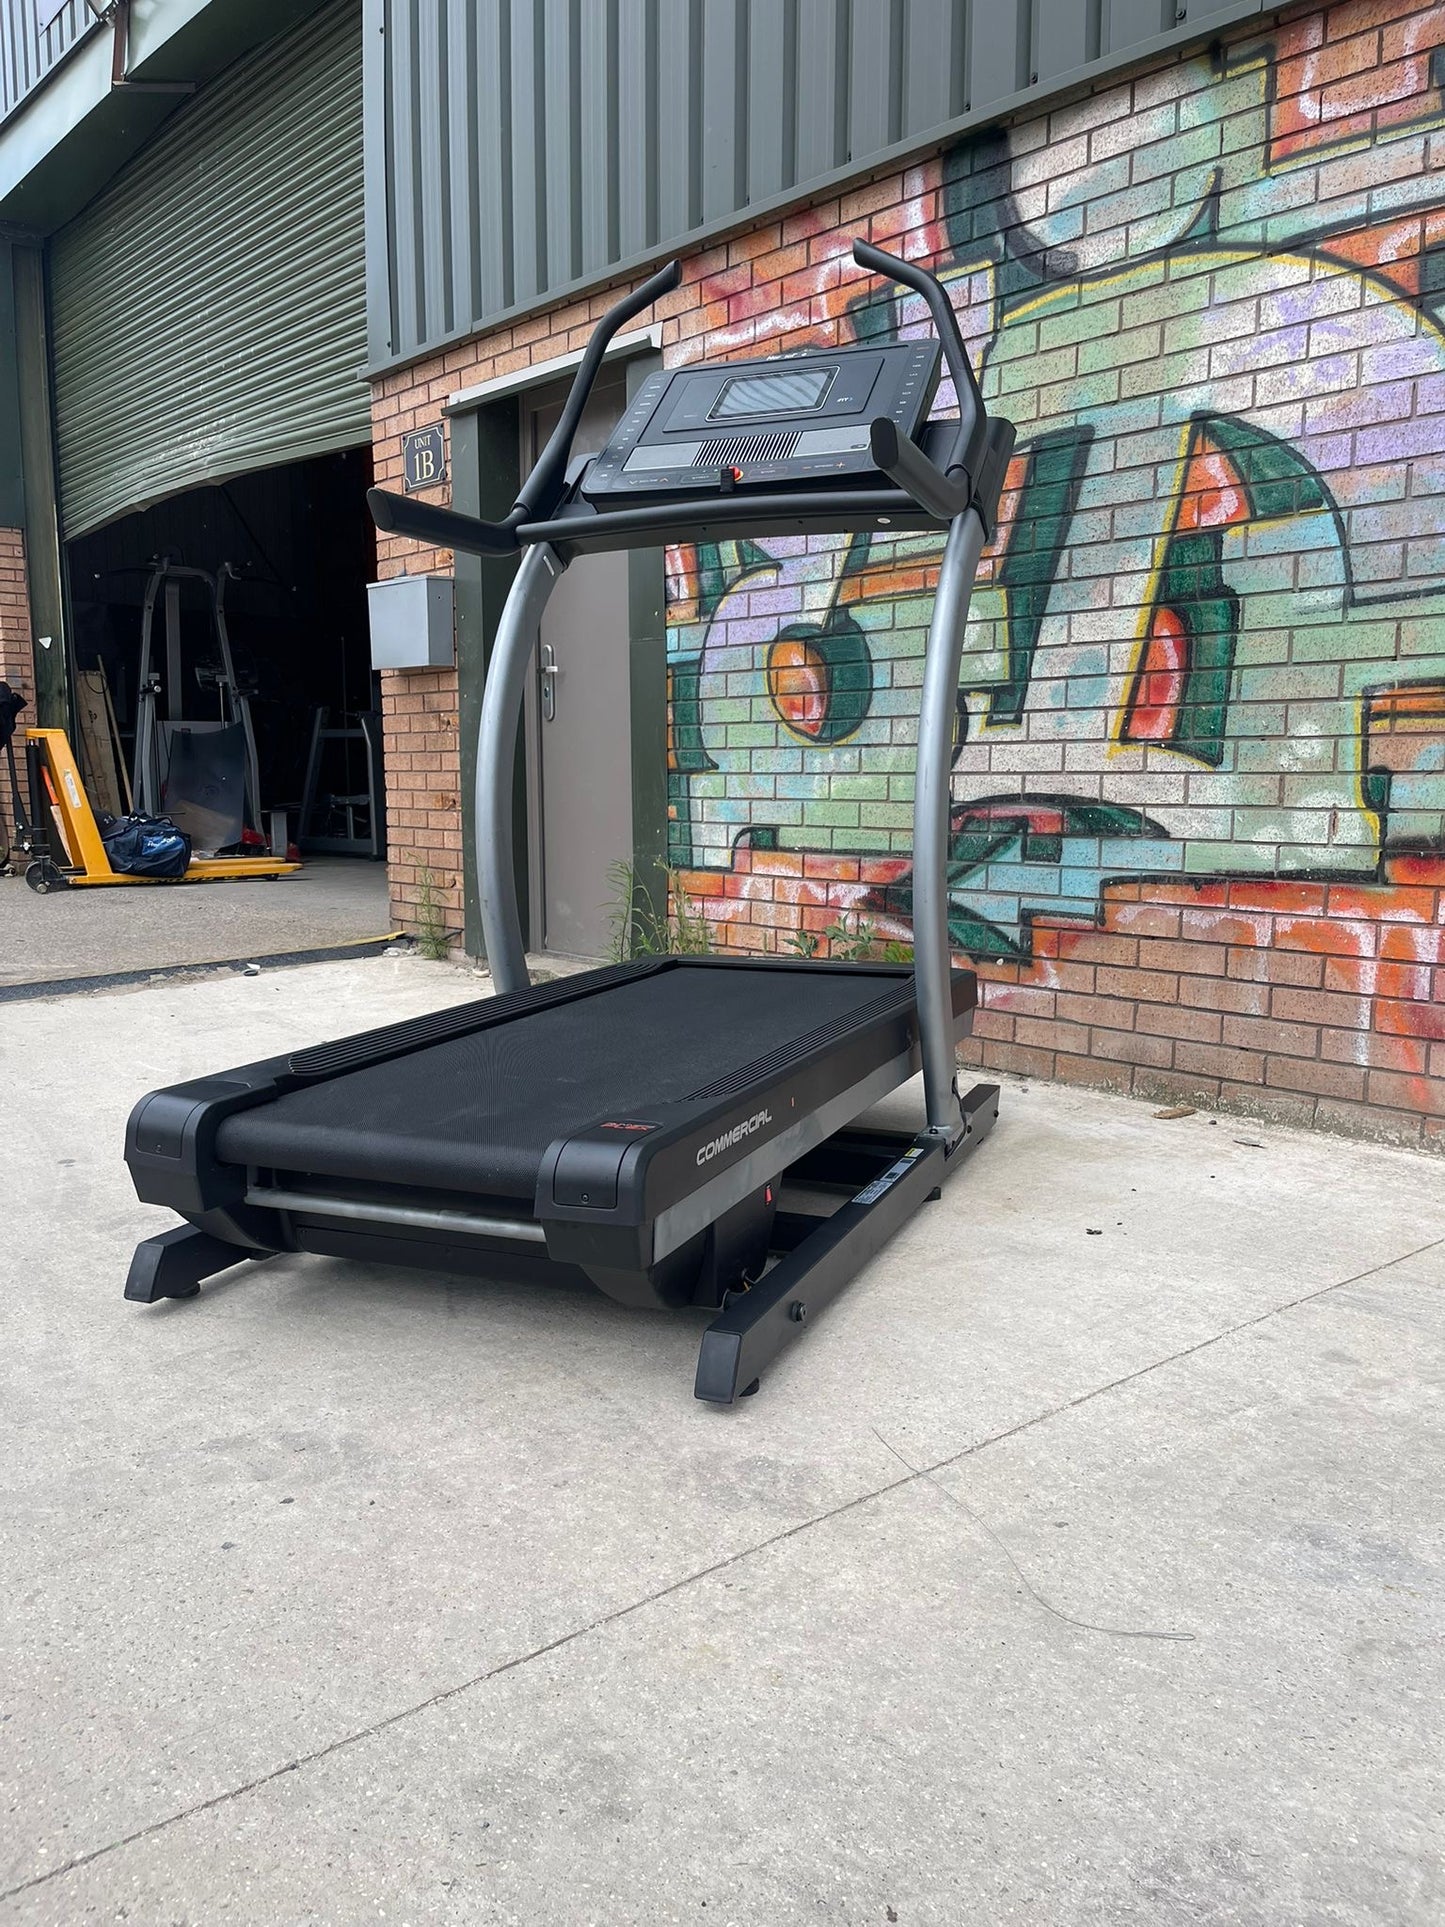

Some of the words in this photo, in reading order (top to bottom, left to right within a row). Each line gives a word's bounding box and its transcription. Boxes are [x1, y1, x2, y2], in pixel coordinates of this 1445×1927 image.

[414, 435, 432, 449] UNIT
[414, 450, 435, 482] 1B
[696, 1108, 773, 1166] COMMERCIAL
